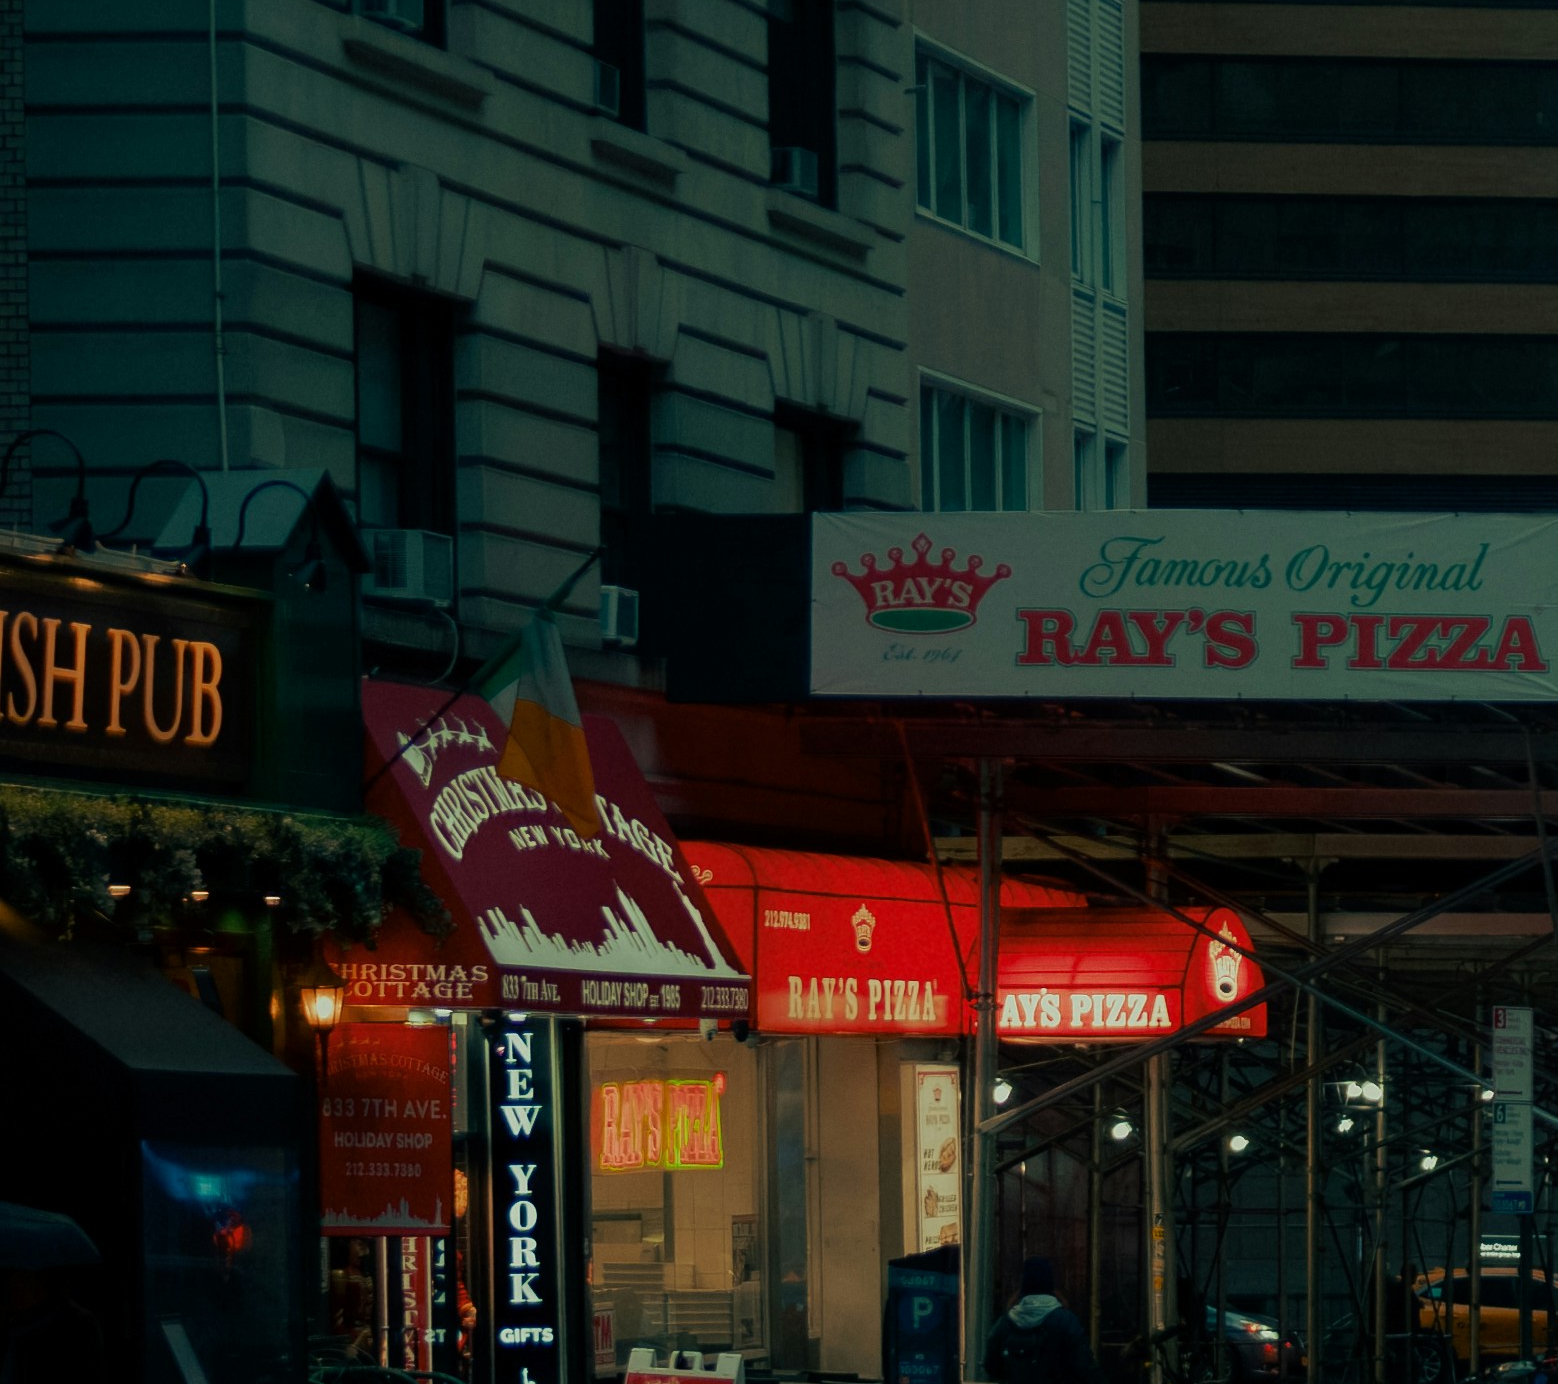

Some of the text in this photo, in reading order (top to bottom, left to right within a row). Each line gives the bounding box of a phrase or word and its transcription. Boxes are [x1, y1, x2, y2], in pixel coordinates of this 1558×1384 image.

[1080, 536, 1490, 607] Famous Original
[871, 576, 974, 608] RAY'S
[1016, 608, 1549, 673] RAY'S PIZZA
[106, 626, 223, 747] PUB
[507, 824, 549, 852] NEW
[502, 974, 520, 1000] 833
[583, 979, 622, 1007] HOLIDAY
[623, 981, 649, 1008] SHOP
[788, 975, 936, 1022] RAY'S PIZZA
[995, 986, 1172, 1028] AY'S PIZZA
[328, 1053, 386, 1076] RISTMAS
[322, 1097, 448, 1120] 833 7TH AVE.
[1496, 1104, 1504, 1123] 6
[334, 1130, 433, 1150] HOLIDAY SHOP
[500, 1031, 543, 1305] NEW YORK
[912, 1295, 934, 1328] P
[499, 1326, 555, 1345] GIFTS
